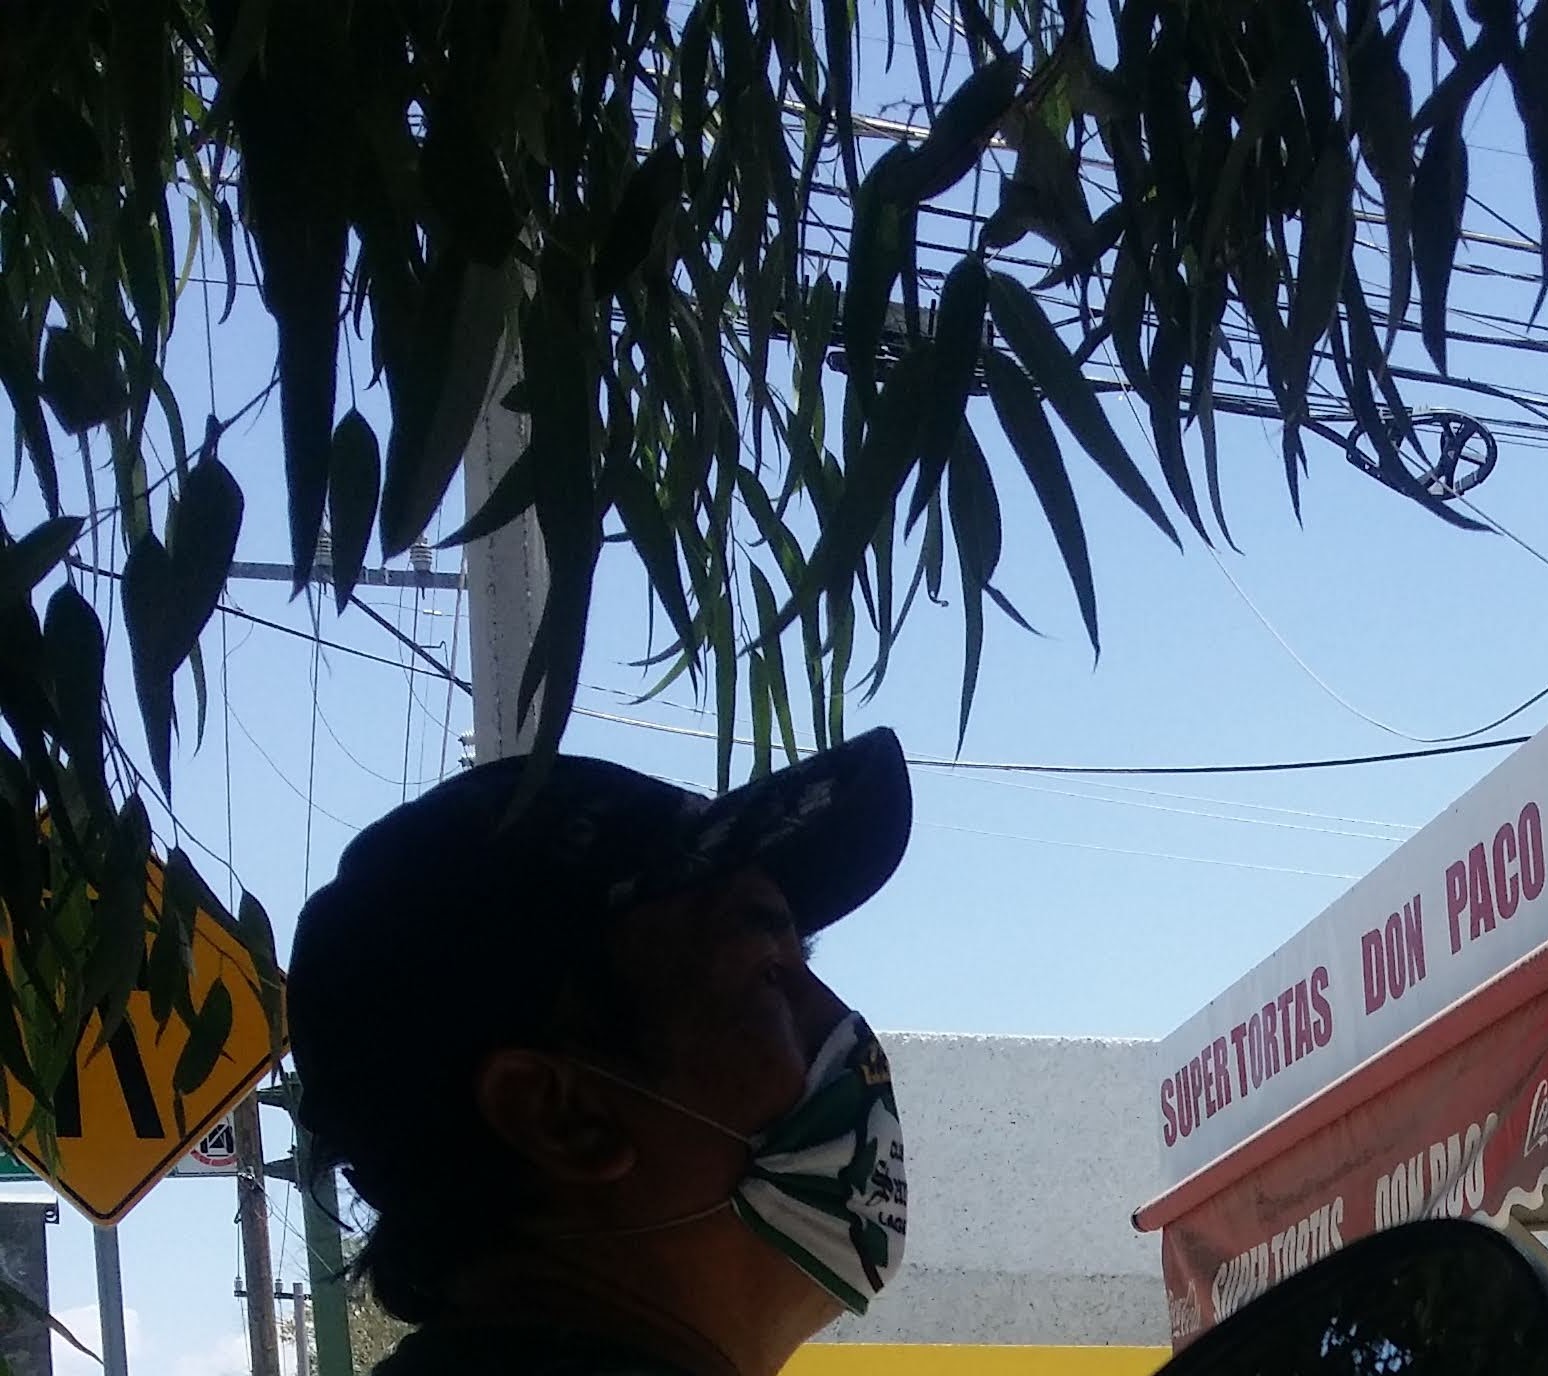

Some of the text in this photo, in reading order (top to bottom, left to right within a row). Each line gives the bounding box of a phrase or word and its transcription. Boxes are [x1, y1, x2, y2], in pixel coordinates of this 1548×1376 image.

[1160, 801, 1546, 1148] SUPER TORTAS DON PACO
[1271, 1196, 1344, 1284] TORTAS
